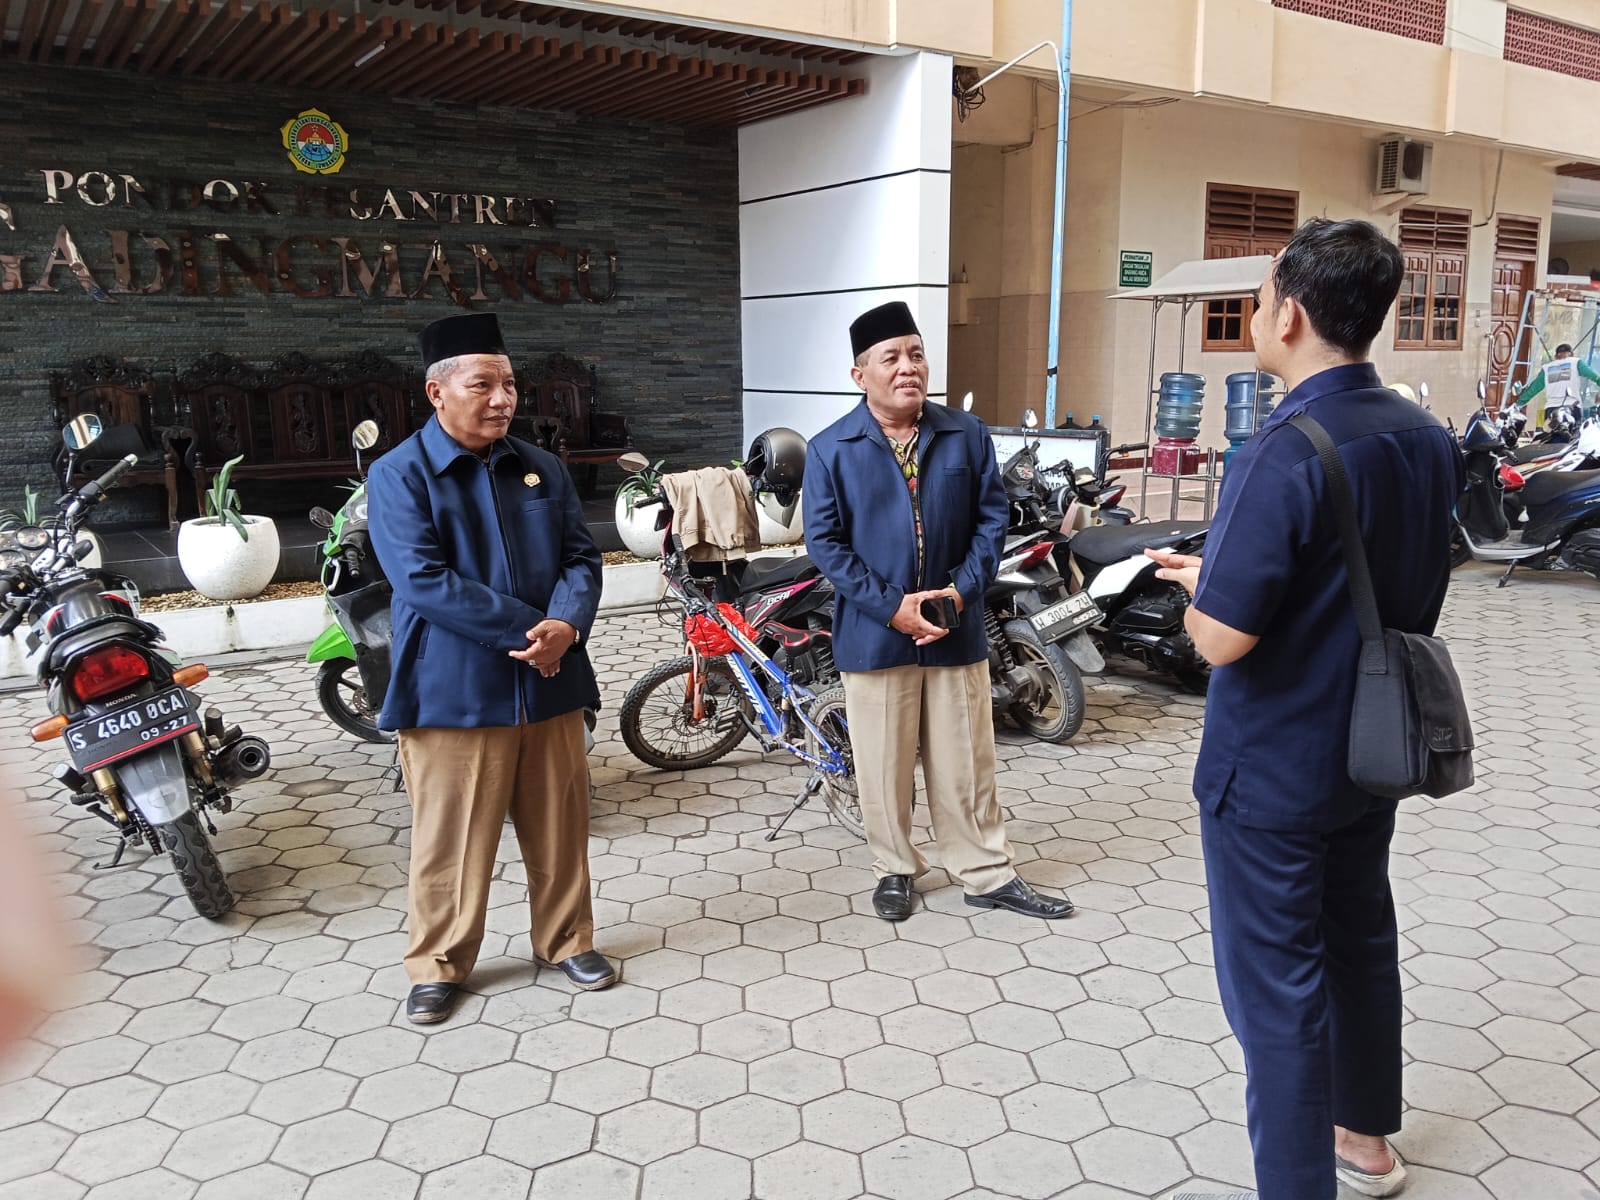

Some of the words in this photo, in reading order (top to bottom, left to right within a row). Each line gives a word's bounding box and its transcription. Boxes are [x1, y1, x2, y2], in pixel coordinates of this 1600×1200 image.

[40, 169, 281, 216] PONDOK
[297, 183, 555, 228] PESANTREN
[105, 693, 137, 707] HONDA
[71, 733, 87, 750] S
[97, 711, 142, 738] 4640
